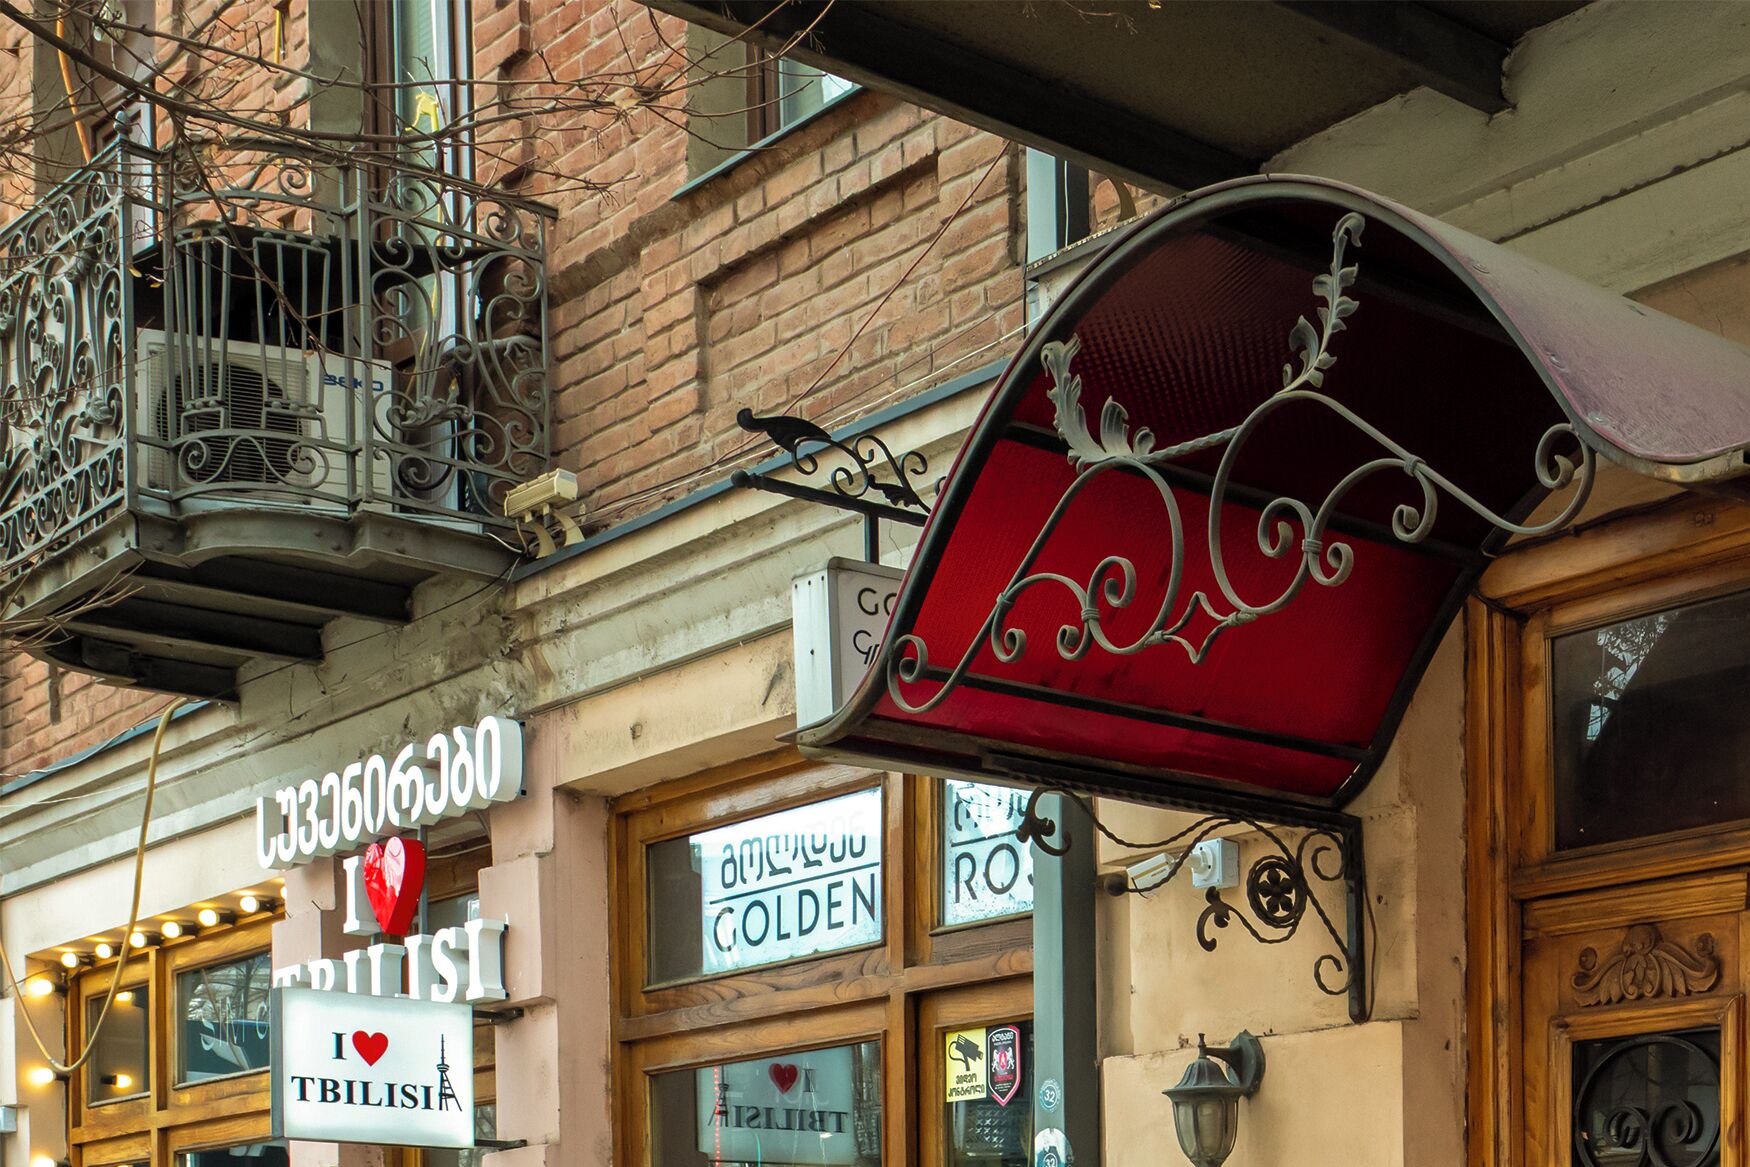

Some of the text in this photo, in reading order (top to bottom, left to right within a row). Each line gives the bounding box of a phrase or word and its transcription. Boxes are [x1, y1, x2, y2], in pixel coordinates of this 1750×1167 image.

[256, 715, 503, 870] სუვენირები
[954, 842, 1034, 904] RO
[713, 872, 877, 954] GOLDEN
[331, 1031, 348, 1061] I
[290, 1075, 435, 1111] TBILISI
